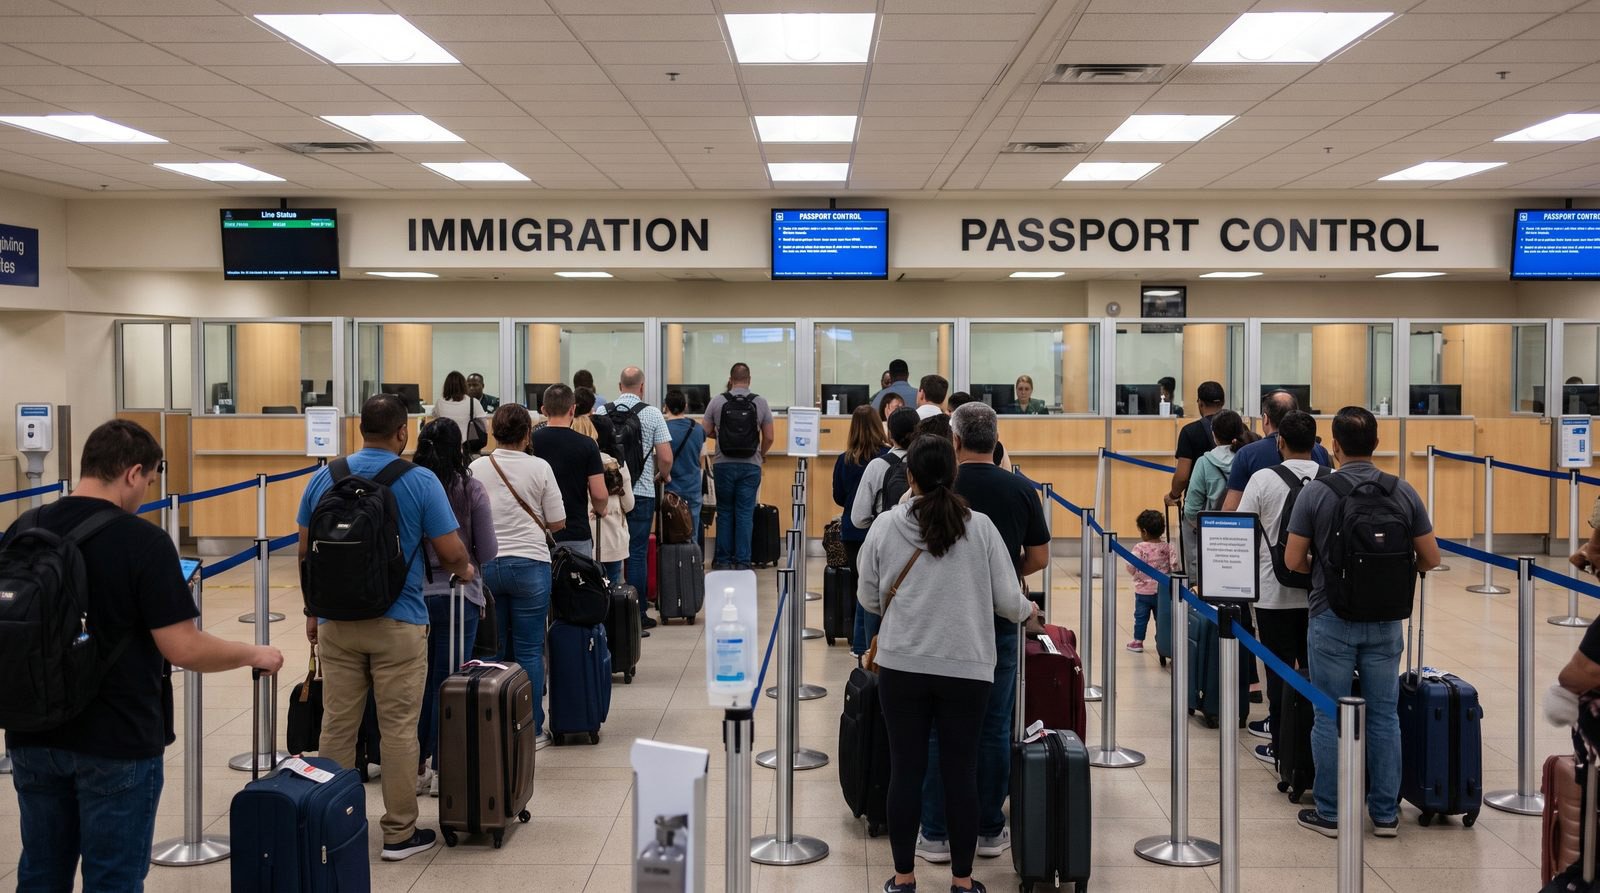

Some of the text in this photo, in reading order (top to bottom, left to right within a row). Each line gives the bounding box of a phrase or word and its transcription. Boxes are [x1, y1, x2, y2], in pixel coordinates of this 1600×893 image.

[408, 217, 709, 252] IMMIGRATION
[1543, 213, 1576, 221] PASSPORT
[962, 217, 1440, 253] PASSPORT CONTROL
